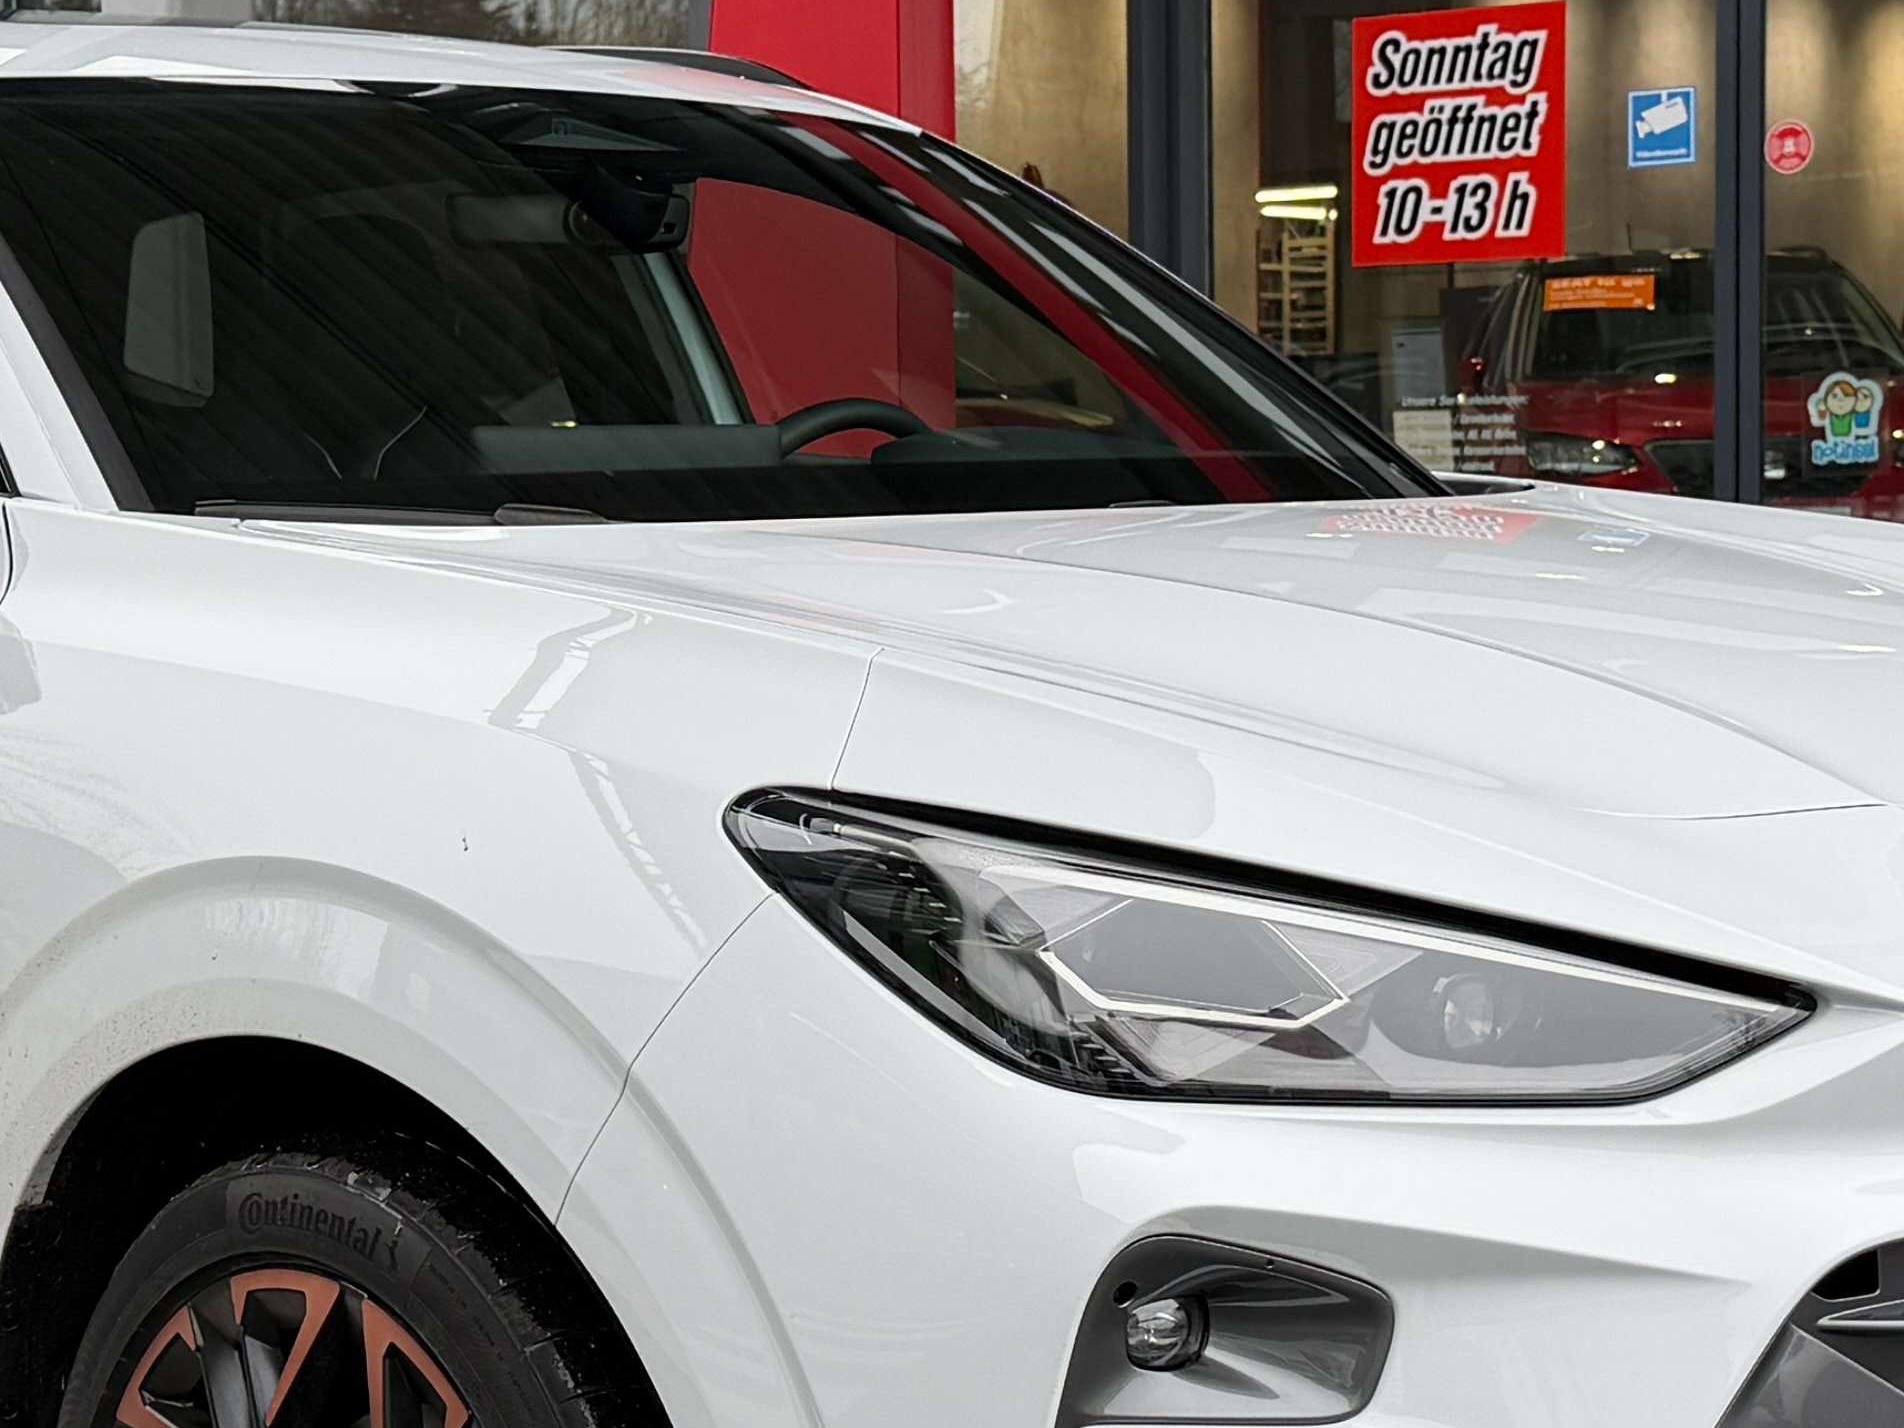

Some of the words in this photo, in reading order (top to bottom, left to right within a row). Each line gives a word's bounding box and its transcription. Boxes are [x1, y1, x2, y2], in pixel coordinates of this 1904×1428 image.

[1370, 31, 1541, 90] Sonntag
[1368, 99, 1540, 170] geöffnet
[1378, 180, 1493, 238] 10-13
[1501, 179, 1531, 232] h
[238, 1191, 383, 1264] Continental
